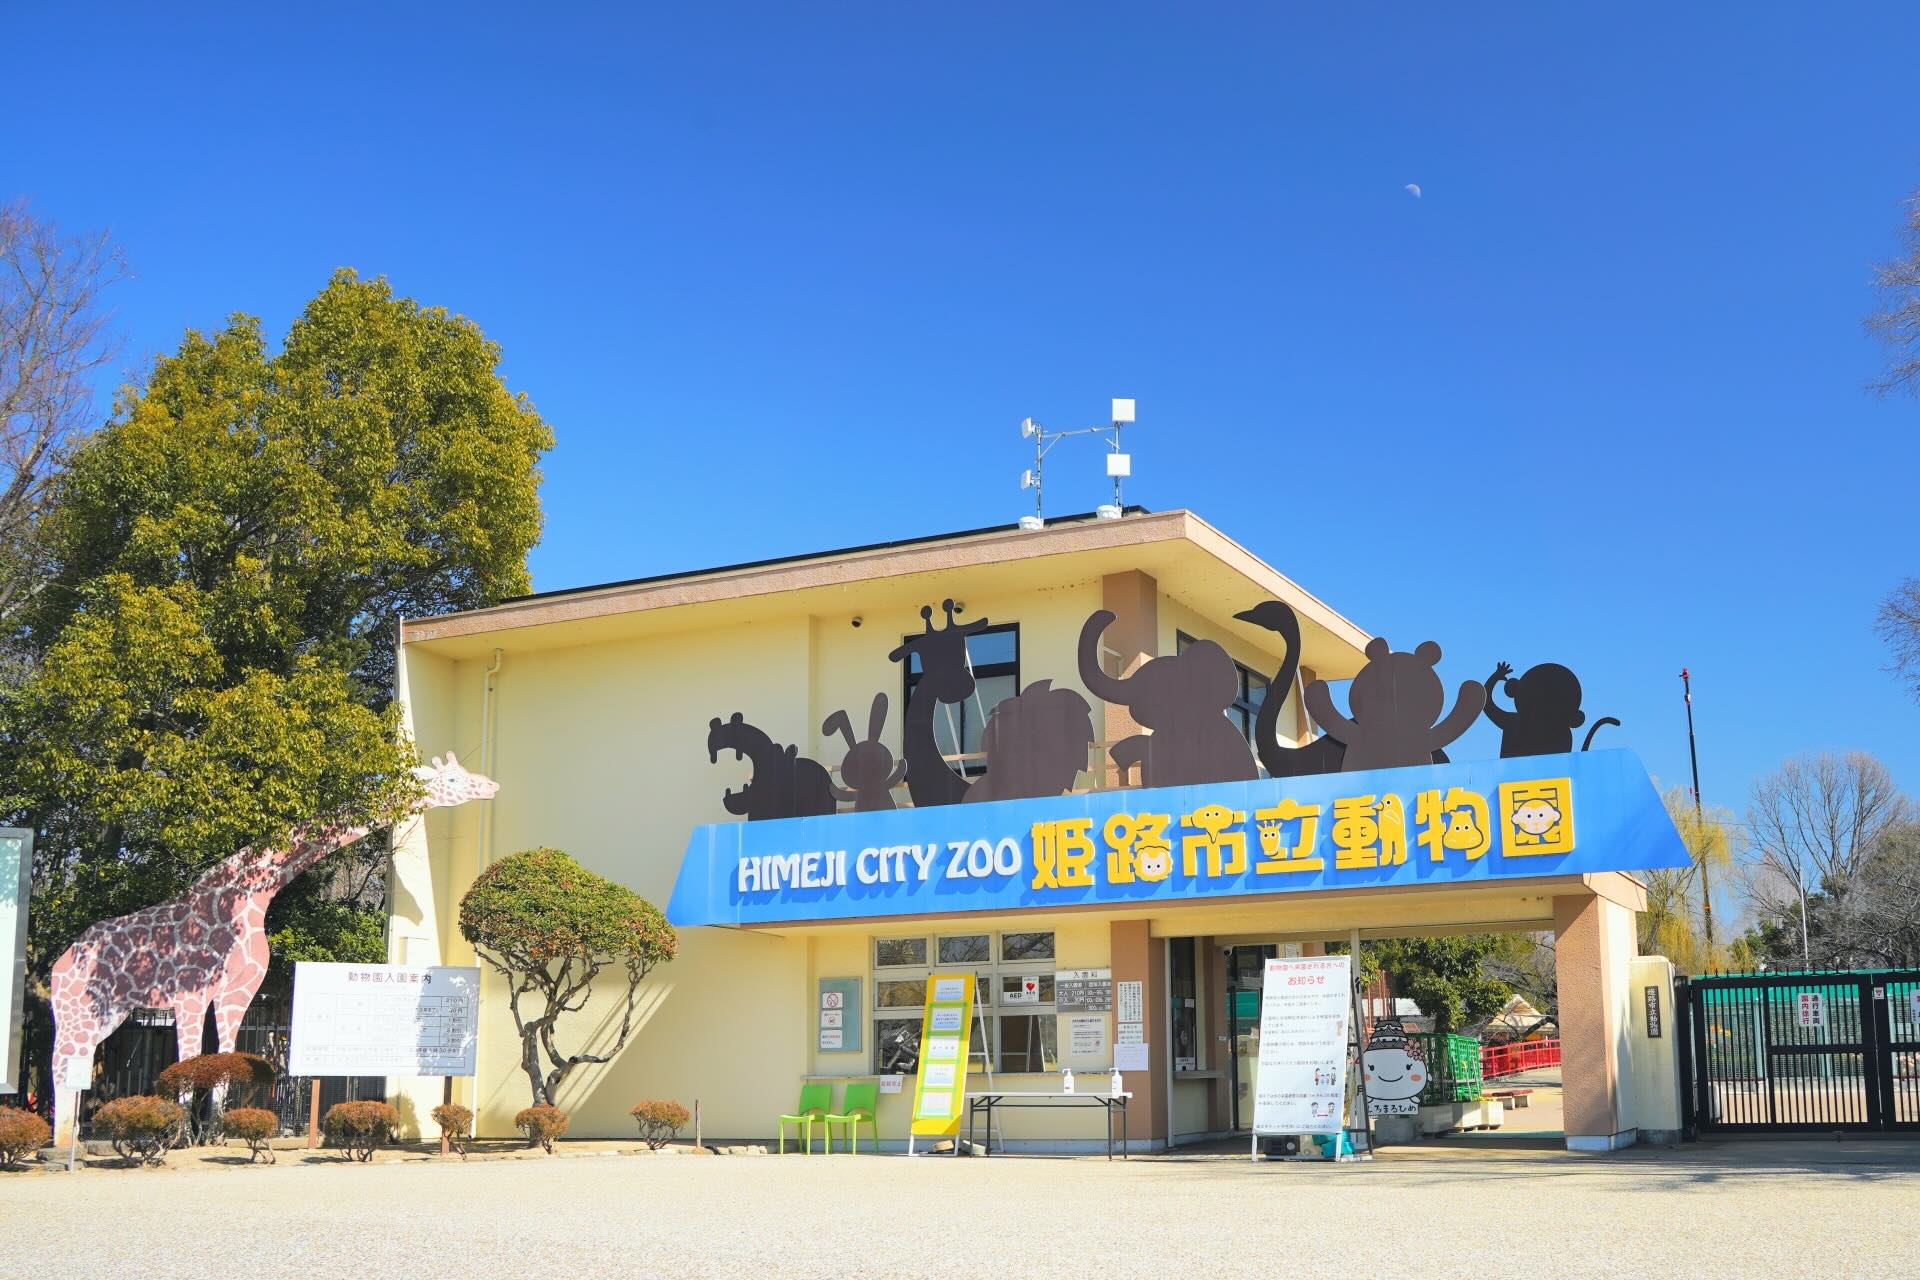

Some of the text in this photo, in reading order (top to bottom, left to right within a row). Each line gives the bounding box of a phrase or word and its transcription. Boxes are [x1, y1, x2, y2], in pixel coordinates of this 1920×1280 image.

[1031, 777, 1576, 890] 姫路市立動物園
[738, 836, 1022, 893] HIMEJI CITY ZOO
[1288, 975, 1326, 986] お知らせ
